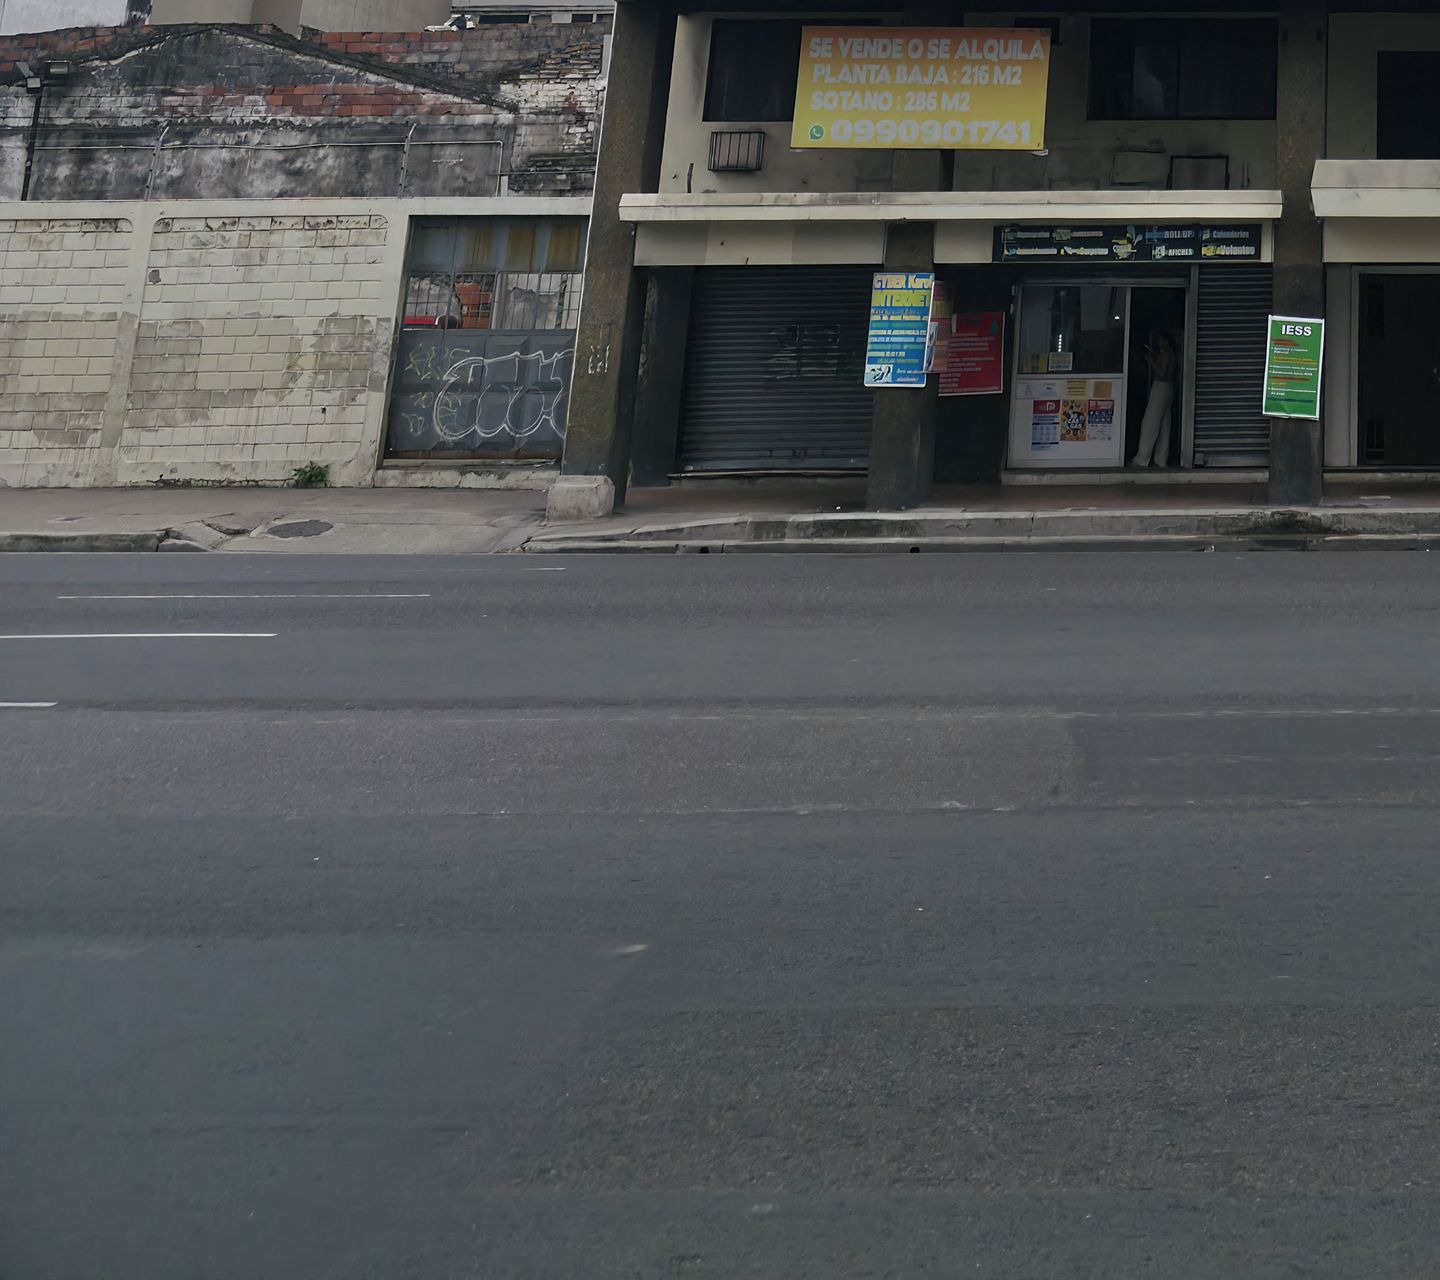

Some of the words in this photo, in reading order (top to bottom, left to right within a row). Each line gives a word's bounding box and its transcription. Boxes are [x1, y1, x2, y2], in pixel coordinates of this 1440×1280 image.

[809, 37, 833, 59] SE
[838, 37, 903, 60] VENDE
[907, 38, 923, 59] O
[927, 38, 950, 60] SE
[954, 39, 1045, 62] ALQUILA
[812, 63, 892, 85] PLANTA
[895, 64, 949, 85] BAJA
[960, 64, 988, 85] 216
[992, 65, 1022, 85] M2
[810, 91, 893, 112] SOTANO
[941, 92, 971, 112] M2
[830, 118, 1032, 145] 0990901741
[871, 289, 931, 307] INTERNET
[1281, 324, 1312, 337] IESS
